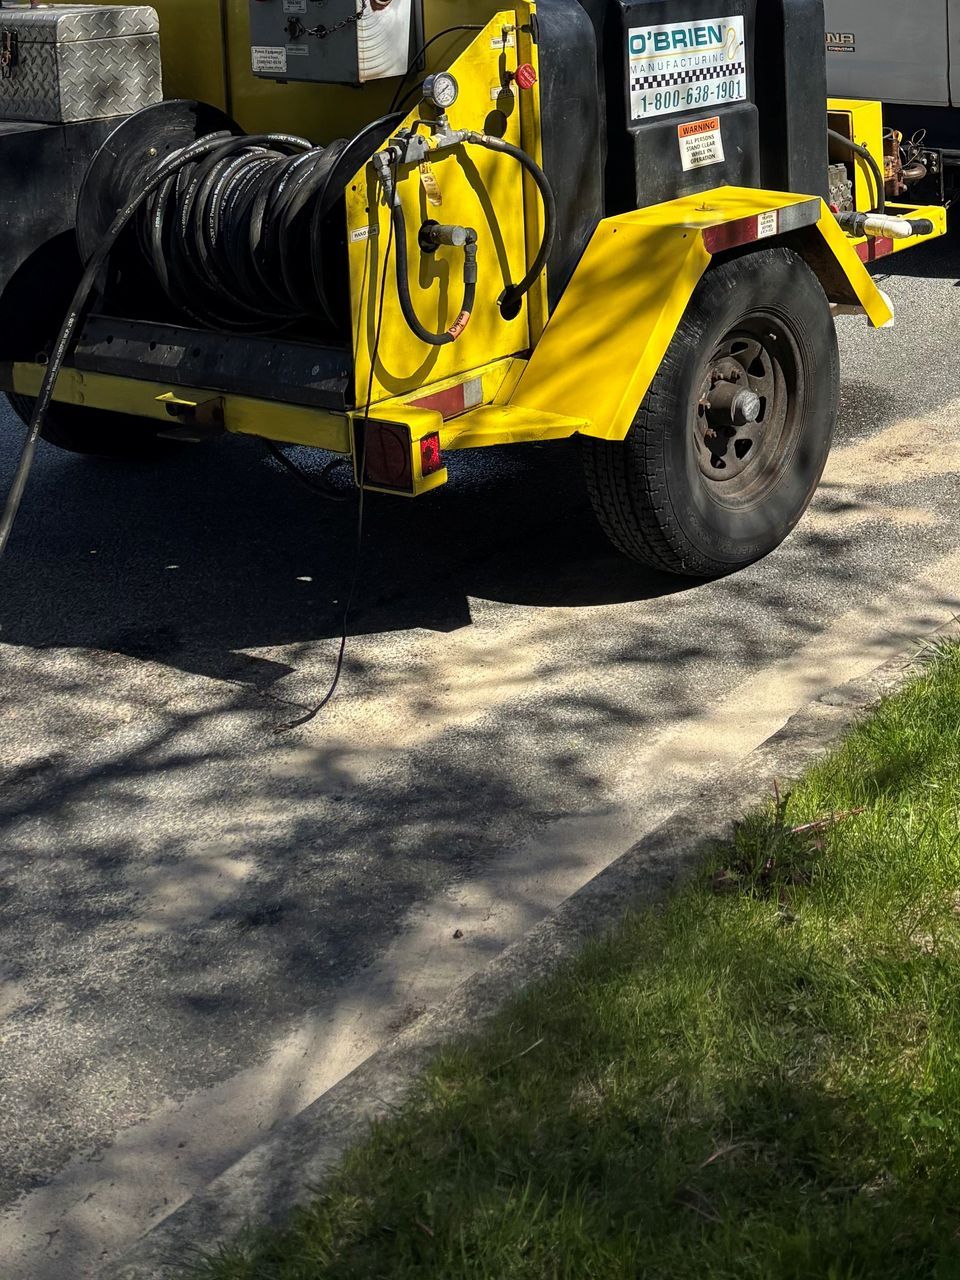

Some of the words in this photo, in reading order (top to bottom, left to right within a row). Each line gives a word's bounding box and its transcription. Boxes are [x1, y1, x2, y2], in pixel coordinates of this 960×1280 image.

[629, 24, 723, 55] O'BRIEN
[631, 53, 725, 74] MANUFACTURING
[641, 80, 741, 113] 1-800-638-1901
[682, 121, 715, 135] WARNING
